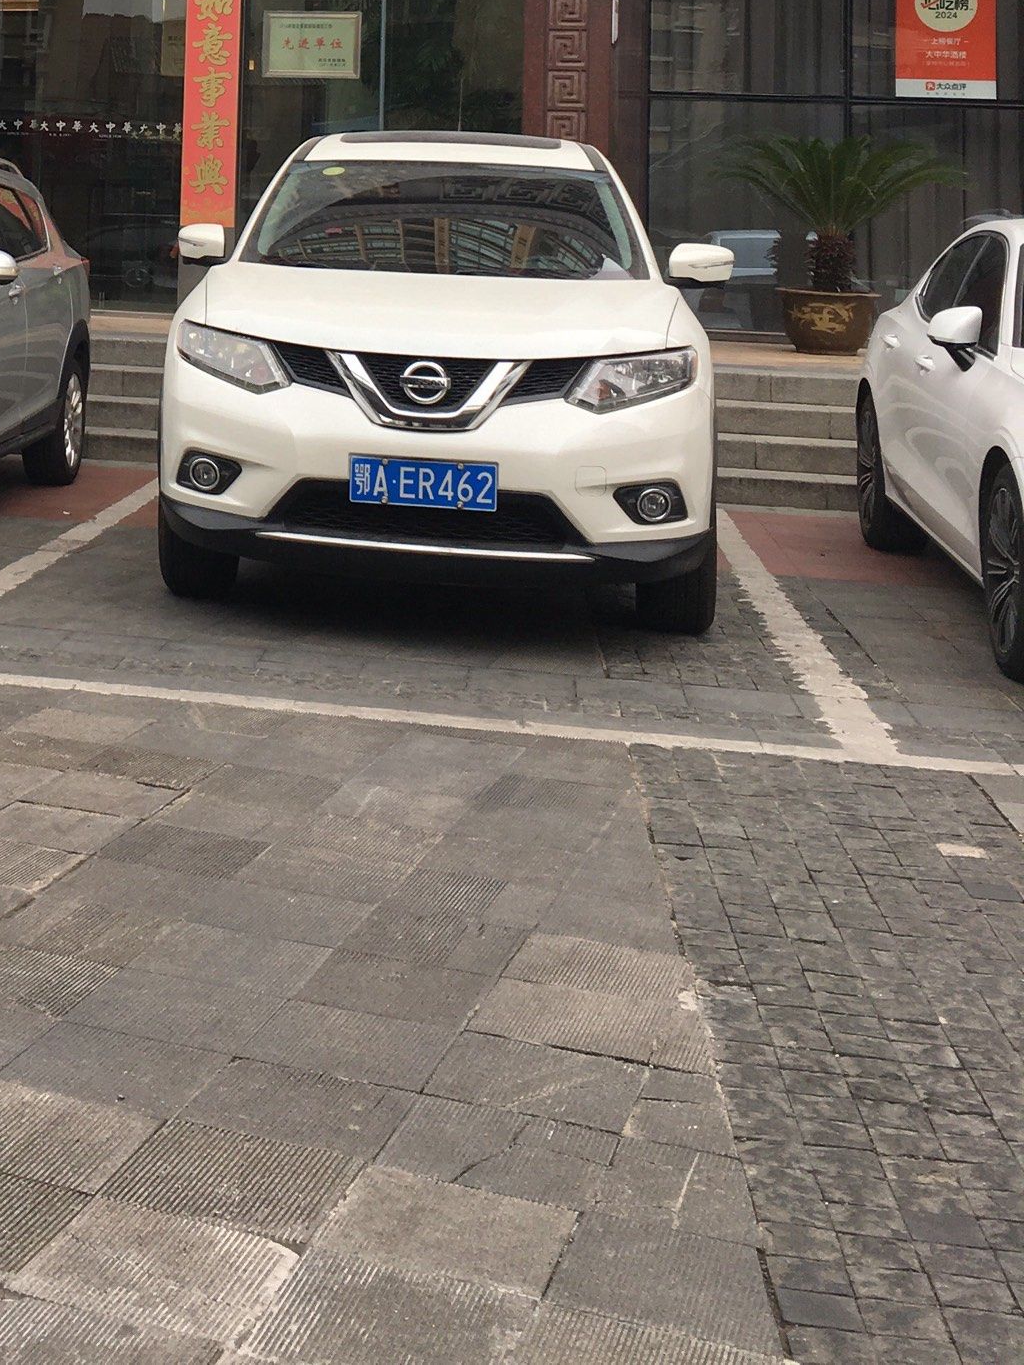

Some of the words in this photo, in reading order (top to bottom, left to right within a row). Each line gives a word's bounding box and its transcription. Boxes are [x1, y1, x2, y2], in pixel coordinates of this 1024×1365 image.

[935, 11, 958, 19] 2024
[282, 36, 343, 50] 先进单位
[926, 50, 968, 59] 大中华酒楼
[936, 82, 967, 91] 大众点评
